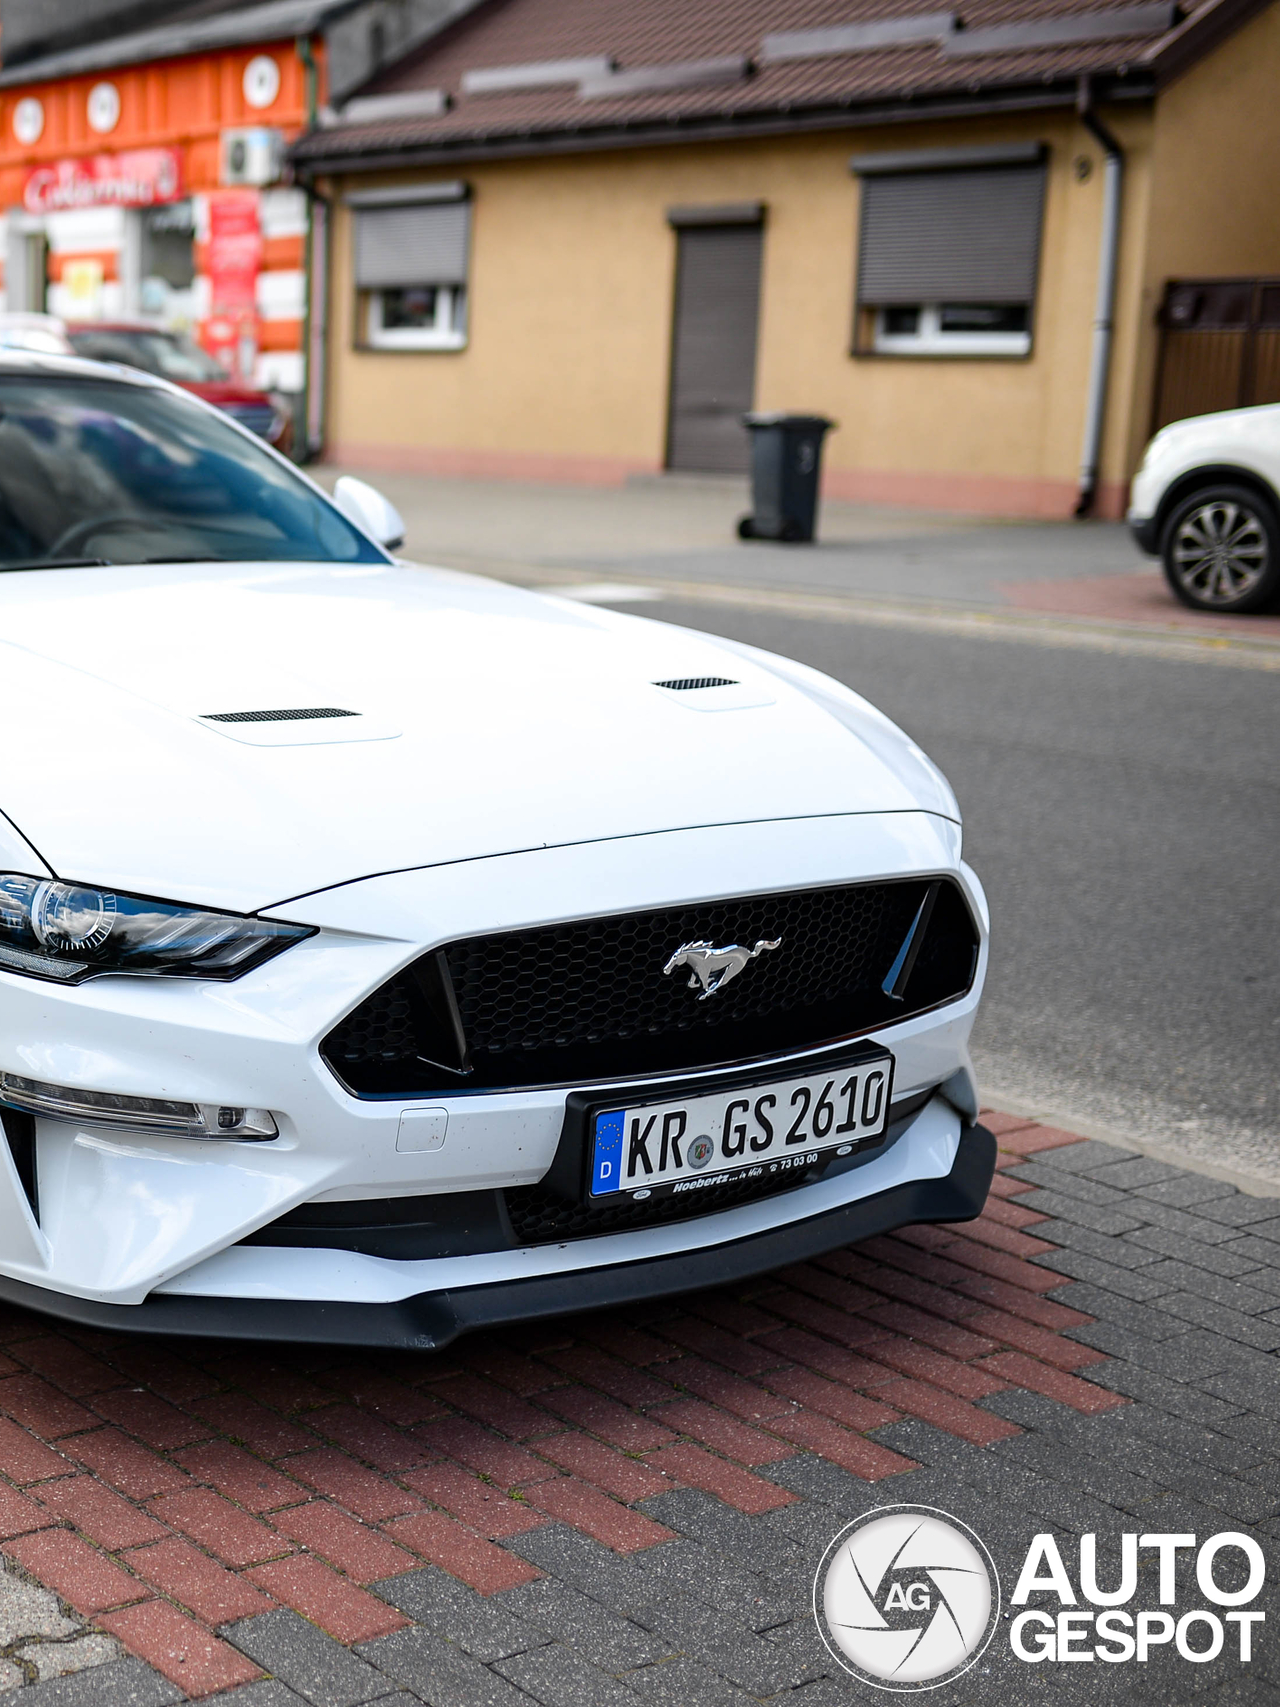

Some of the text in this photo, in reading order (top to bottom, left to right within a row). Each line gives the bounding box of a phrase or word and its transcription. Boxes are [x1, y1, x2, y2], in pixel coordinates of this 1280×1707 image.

[627, 1110, 688, 1178] KR
[721, 1093, 777, 1158] GS
[785, 1070, 885, 1146] 2610
[600, 1161, 612, 1179] D
[780, 1159, 792, 1170] 73
[793, 1156, 805, 1167] 03
[806, 1153, 818, 1164] 00
